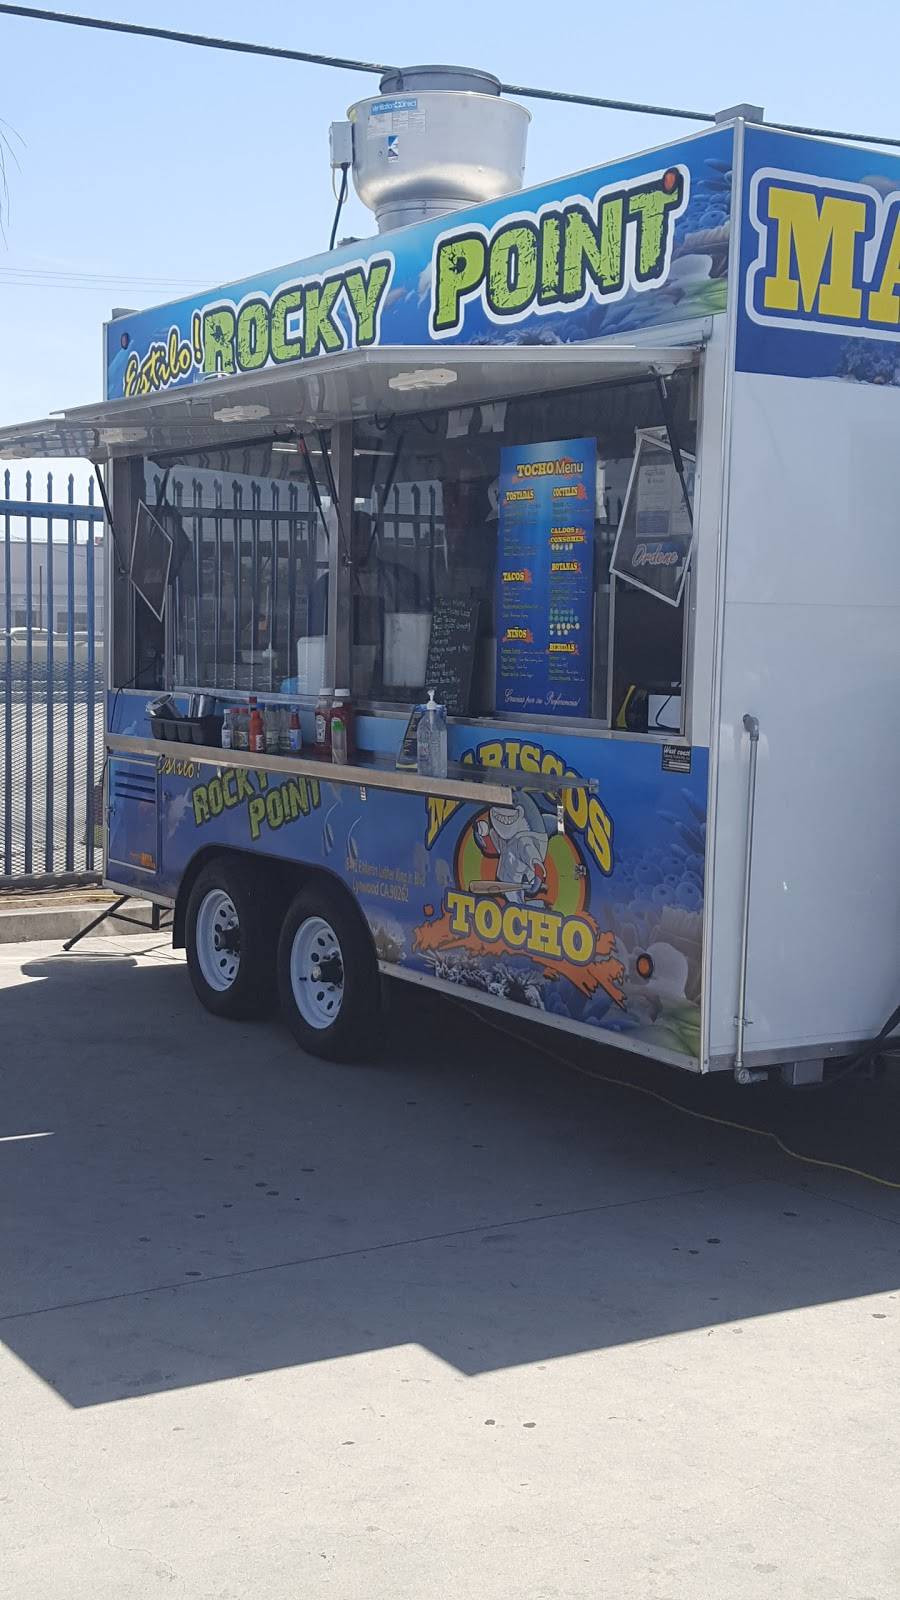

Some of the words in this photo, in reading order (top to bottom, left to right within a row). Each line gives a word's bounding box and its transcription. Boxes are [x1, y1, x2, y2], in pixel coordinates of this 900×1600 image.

[123, 312, 203, 398] Estilo!
[203, 258, 391, 375] ROCKY
[433, 167, 682, 332] POINT
[516, 461, 554, 477] TOCHO
[555, 461, 584, 475] Menu
[502, 571, 525, 582] TACOS
[506, 626, 527, 640] NIÑOS
[445, 889, 597, 965] TOCHO
